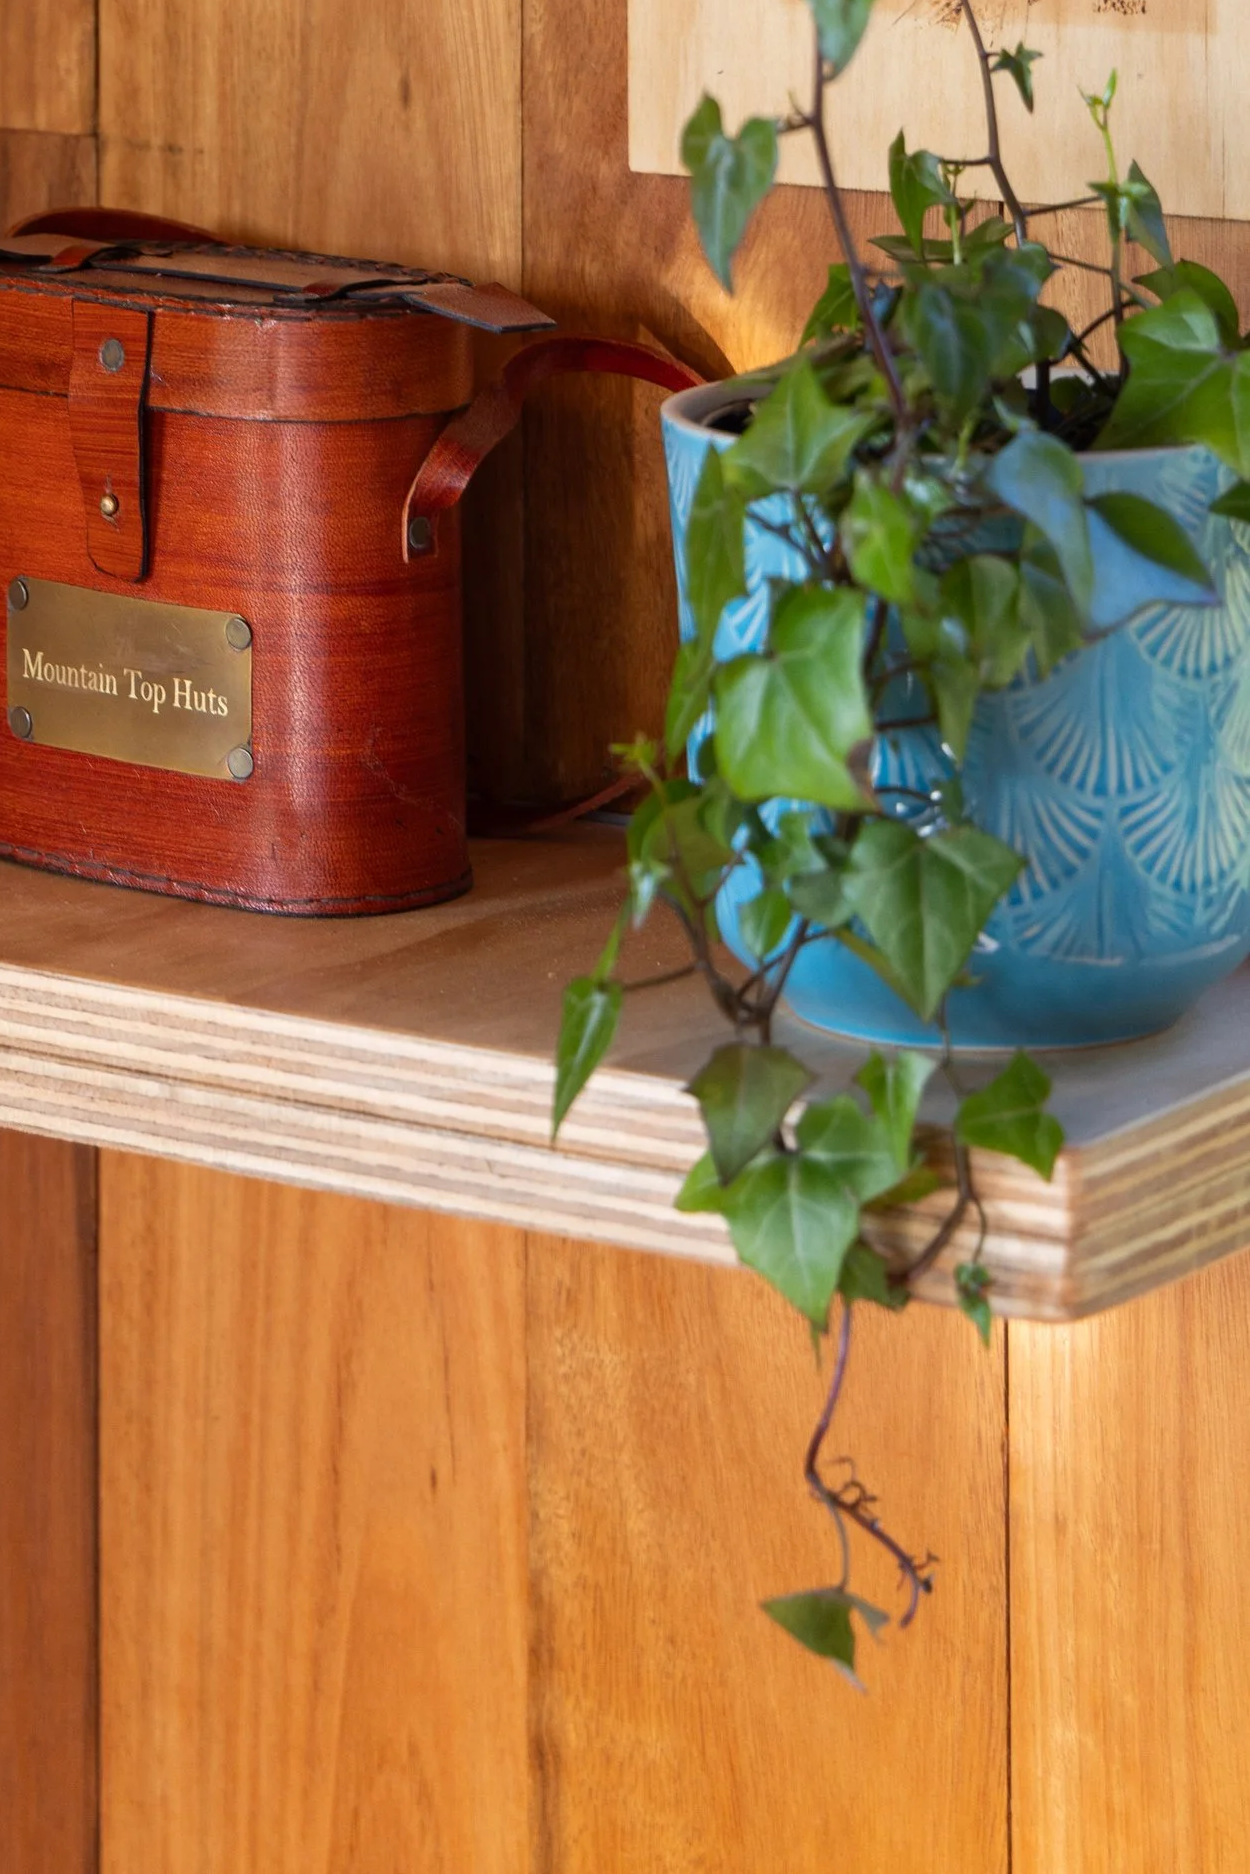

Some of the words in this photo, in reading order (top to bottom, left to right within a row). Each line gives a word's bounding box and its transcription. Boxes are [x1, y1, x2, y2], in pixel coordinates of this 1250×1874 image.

[22, 647, 119, 696] Mountain
[123, 667, 167, 715] Top
[172, 677, 229, 718] Huts
